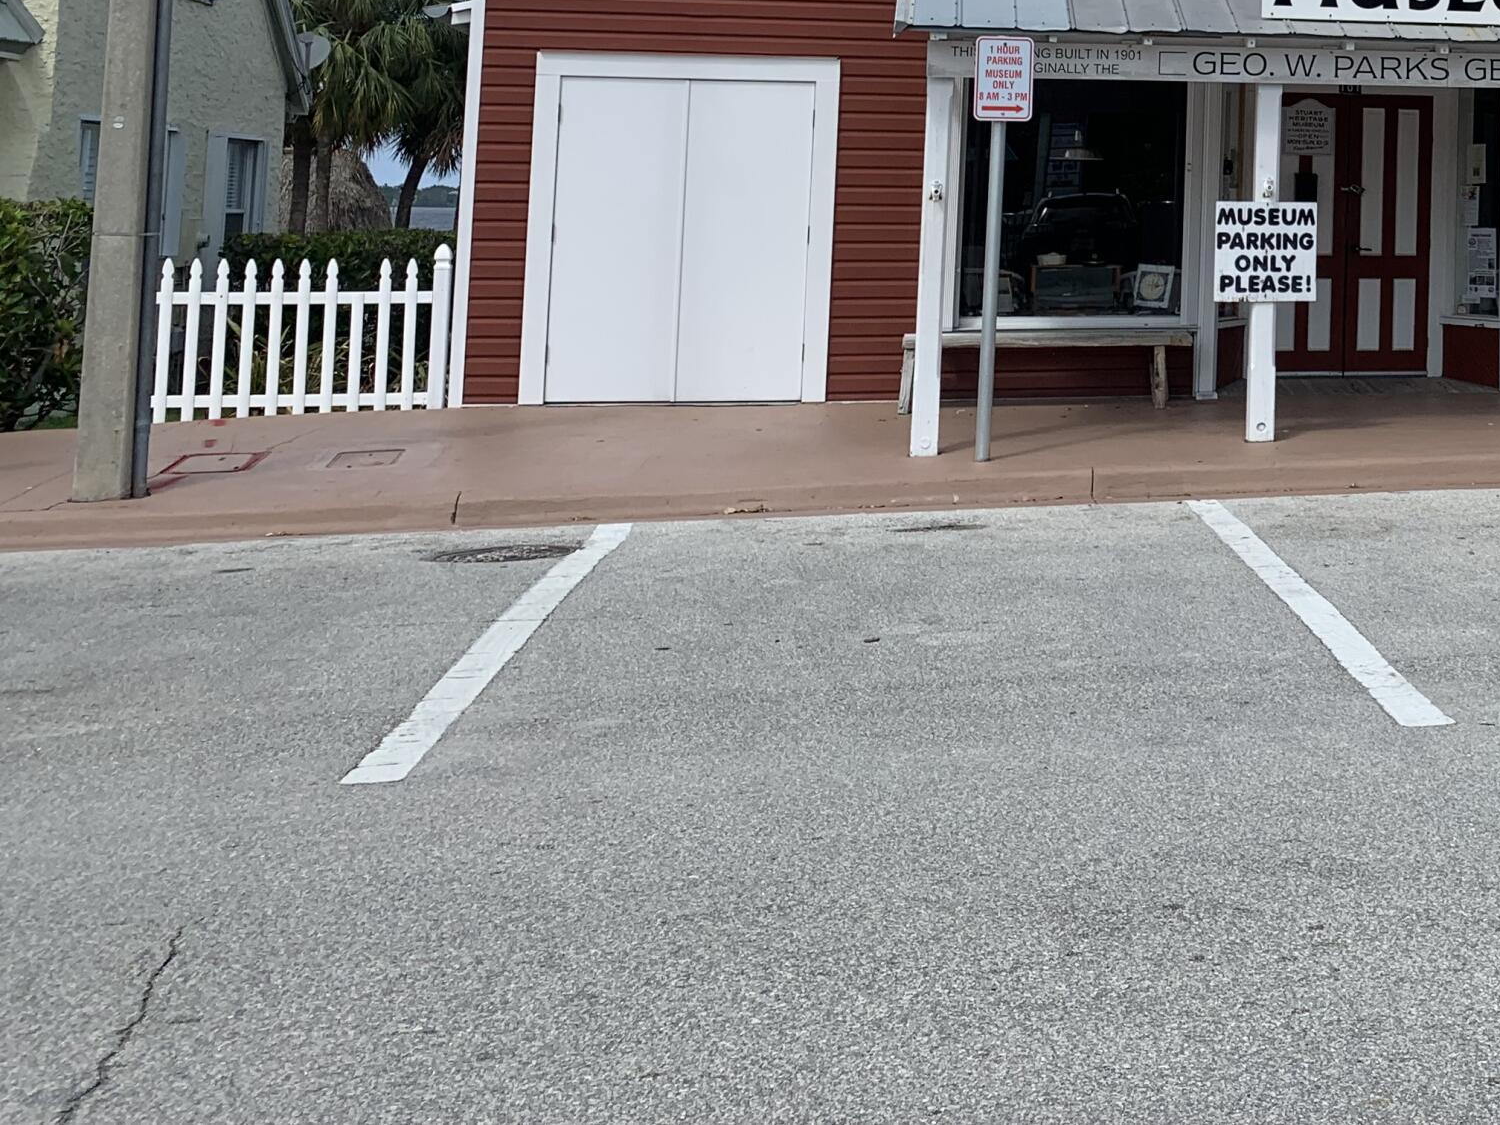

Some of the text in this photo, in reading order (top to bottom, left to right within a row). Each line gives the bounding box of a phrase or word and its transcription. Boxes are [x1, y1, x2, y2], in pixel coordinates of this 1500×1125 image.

[951, 45, 976, 57] THI
[1055, 47, 1092, 60] BUILT
[1096, 49, 1109, 61] IN
[1116, 49, 1142, 62] 1901
[996, 45, 1020, 55] HOUR
[986, 55, 1023, 66] PARKING
[1192, 51, 1274, 77] GEO.
[1284, 53, 1321, 78] W.
[1333, 55, 1450, 81] PARKS
[985, 69, 1022, 79] MUSEUM
[1093, 63, 1119, 75] THE
[992, 80, 1015, 90] ONLY
[985, 92, 999, 101] AM
[1007, 92, 1012, 101] 3
[1014, 92, 1028, 101] PM
[1217, 207, 1316, 226] MUSEUM
[1216, 232, 1314, 250] PARKING
[1234, 254, 1296, 273] ONLY
[1219, 275, 1311, 293] PLEASE!
